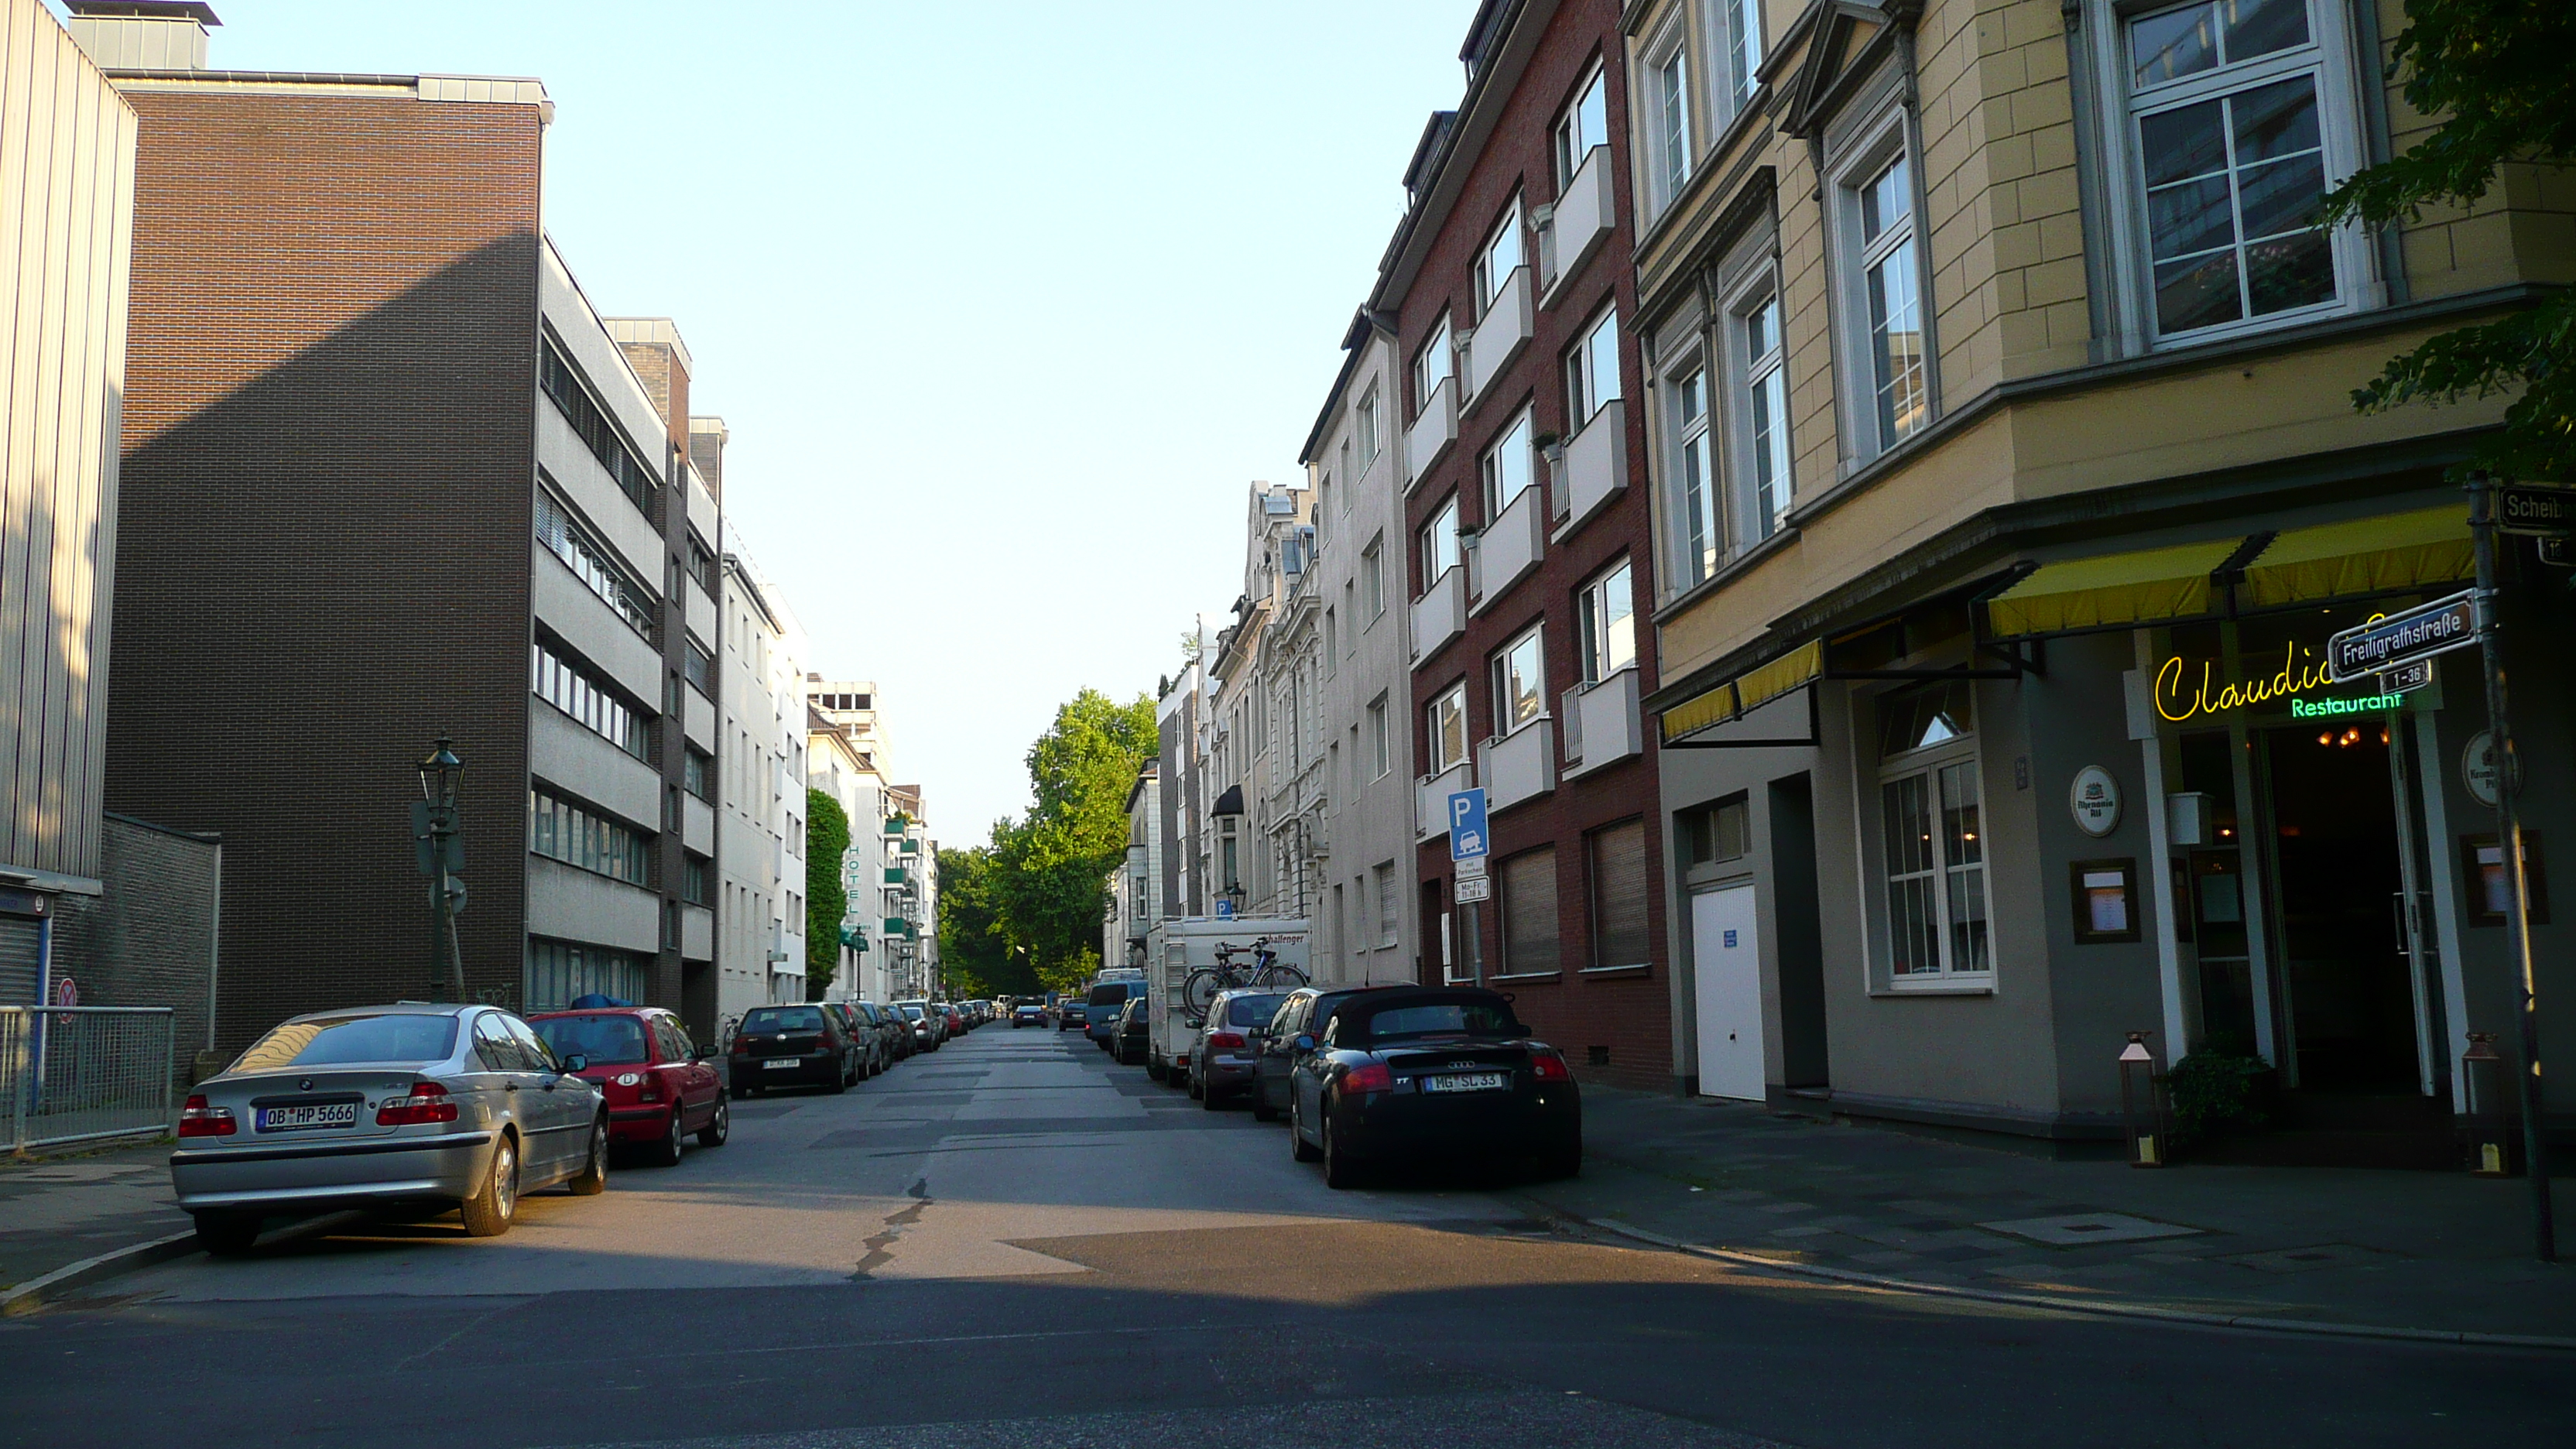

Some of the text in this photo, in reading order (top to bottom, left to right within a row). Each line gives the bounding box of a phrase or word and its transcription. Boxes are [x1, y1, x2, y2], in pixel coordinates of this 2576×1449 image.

[2344, 612, 2461, 666] Freiligrathstraße
[2393, 666, 2420, 687] 1-36
[2292, 694, 2403, 718] Restaurant
[1454, 797, 1471, 827] P
[848, 846, 858, 913] HOTEL
[1461, 881, 1481, 890] Mo-Fr
[1218, 903, 1225, 916] P
[1268, 933, 1304, 945] hallenger
[624, 1074, 632, 1084] D
[1436, 1074, 1496, 1088] MG SL 33
[267, 1105, 354, 1125] OB HP 5666
